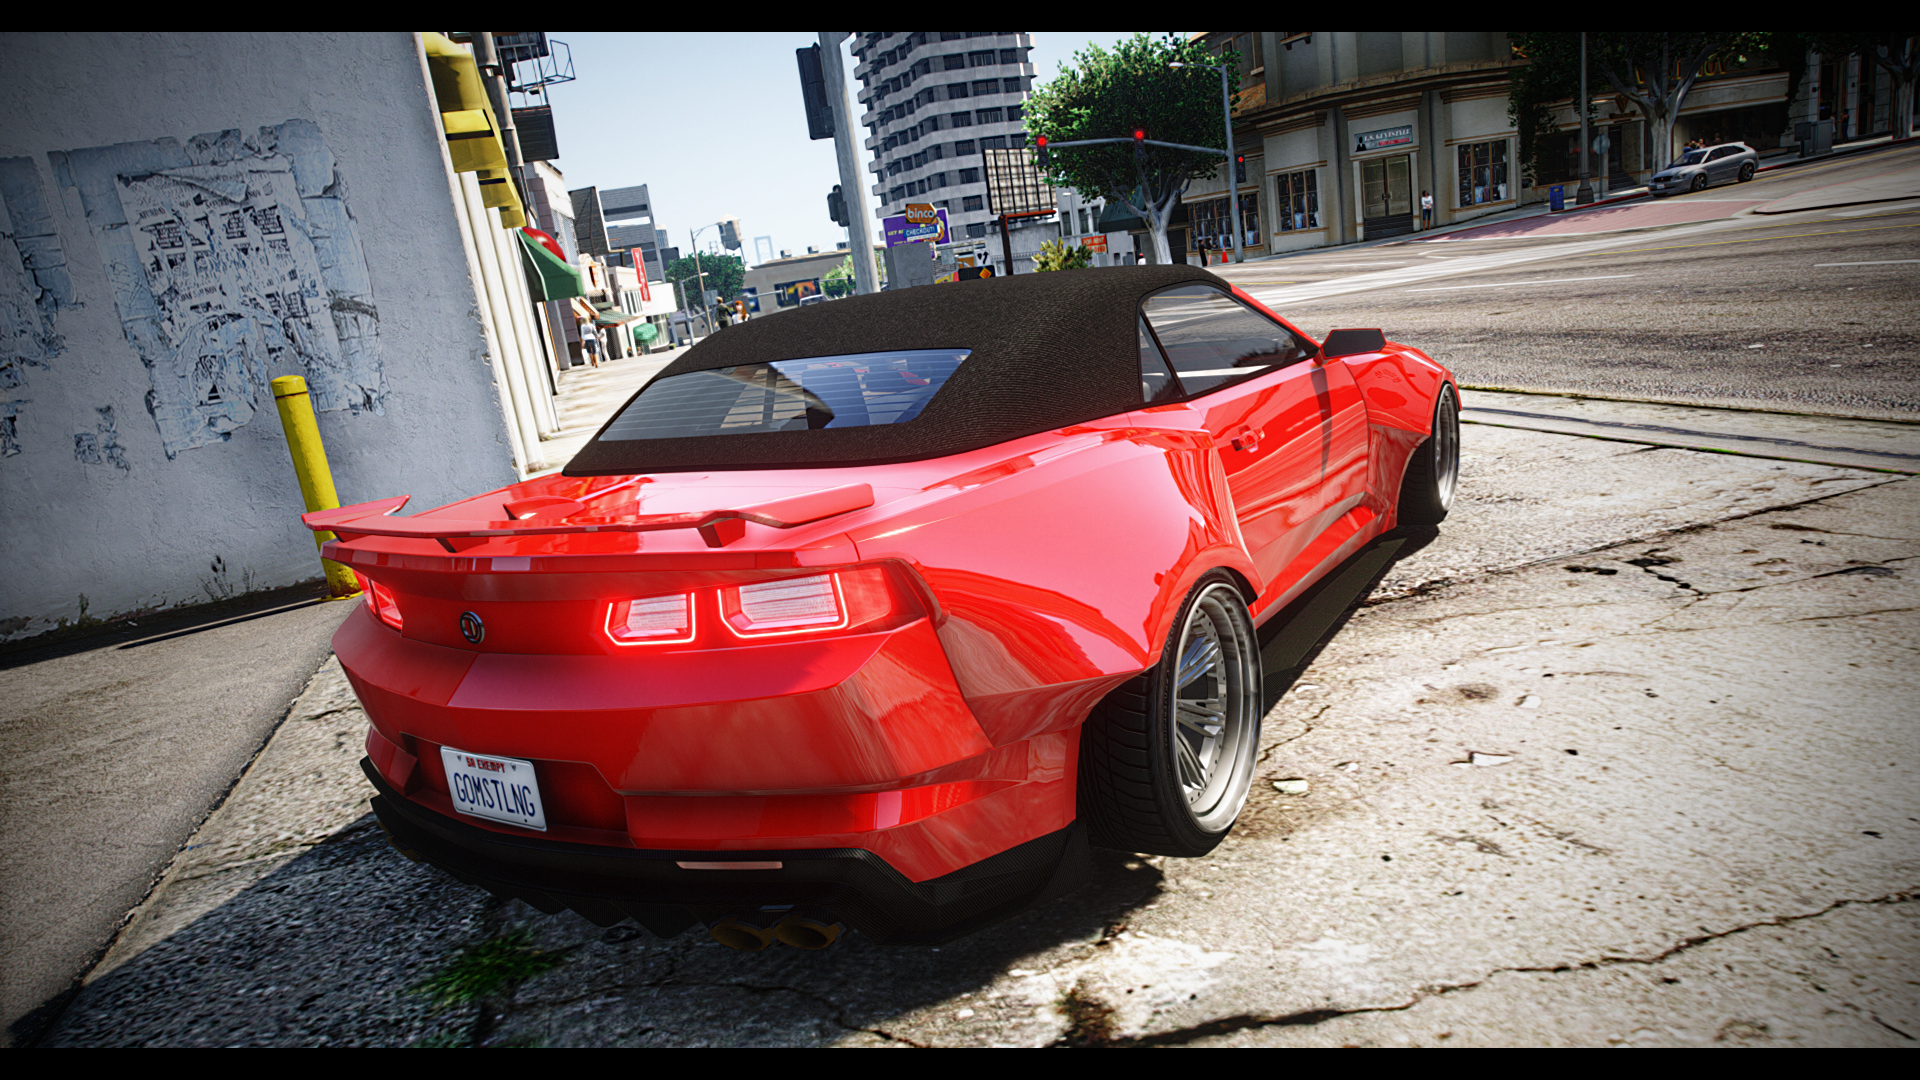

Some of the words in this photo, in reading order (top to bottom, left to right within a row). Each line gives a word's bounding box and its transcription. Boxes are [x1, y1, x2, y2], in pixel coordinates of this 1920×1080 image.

[907, 208, 934, 219] binco
[466, 756, 476, 768] SA
[477, 758, 505, 773] EXEMPT
[453, 772, 535, 817] GOMSTLNG
